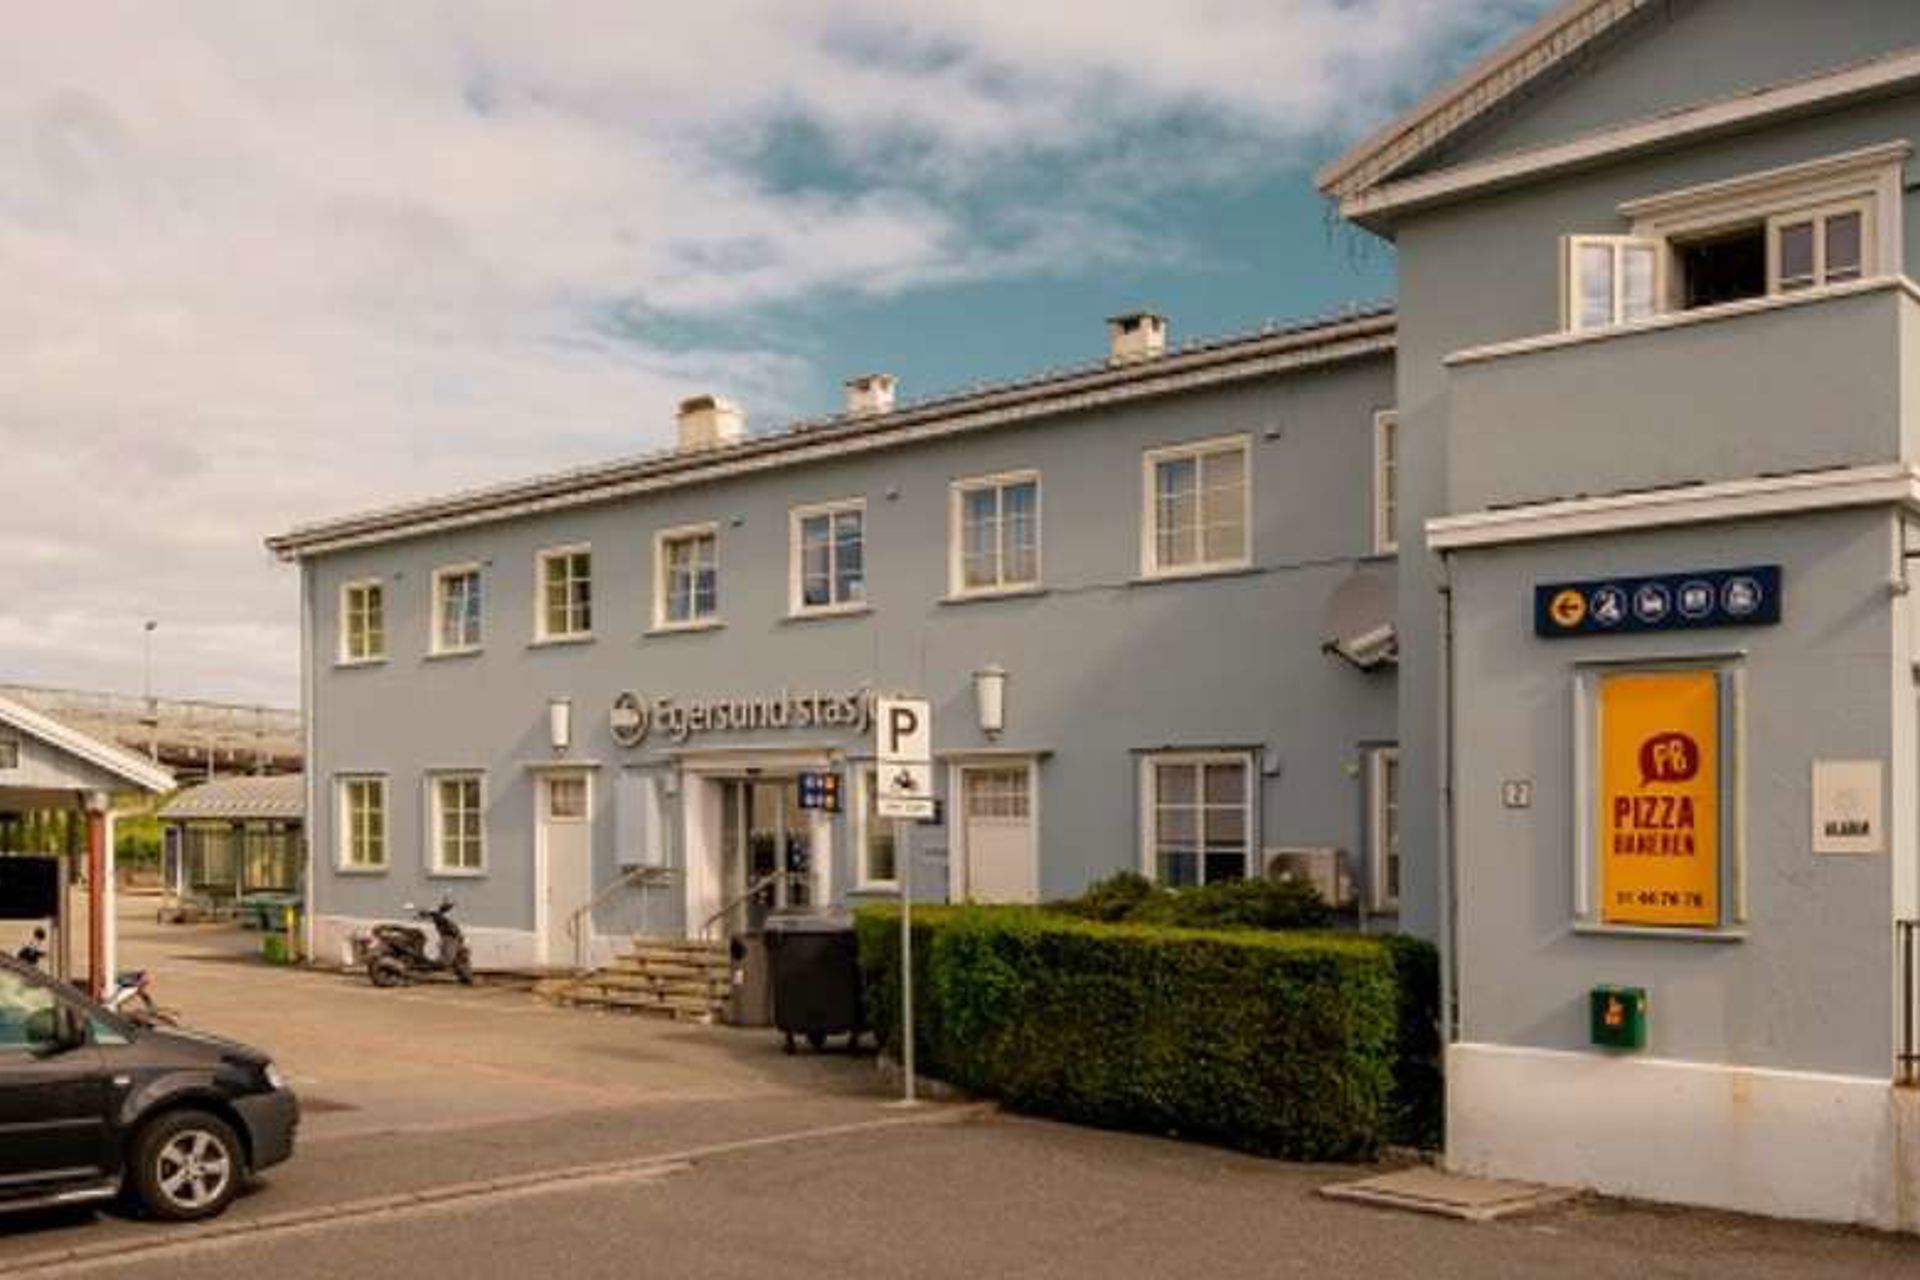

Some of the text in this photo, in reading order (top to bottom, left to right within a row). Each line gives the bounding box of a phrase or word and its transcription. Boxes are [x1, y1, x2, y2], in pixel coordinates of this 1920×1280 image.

[653, 688, 877, 742] Egersund stasj
[889, 708, 918, 752] P
[1614, 796, 1694, 829] PIZZA
